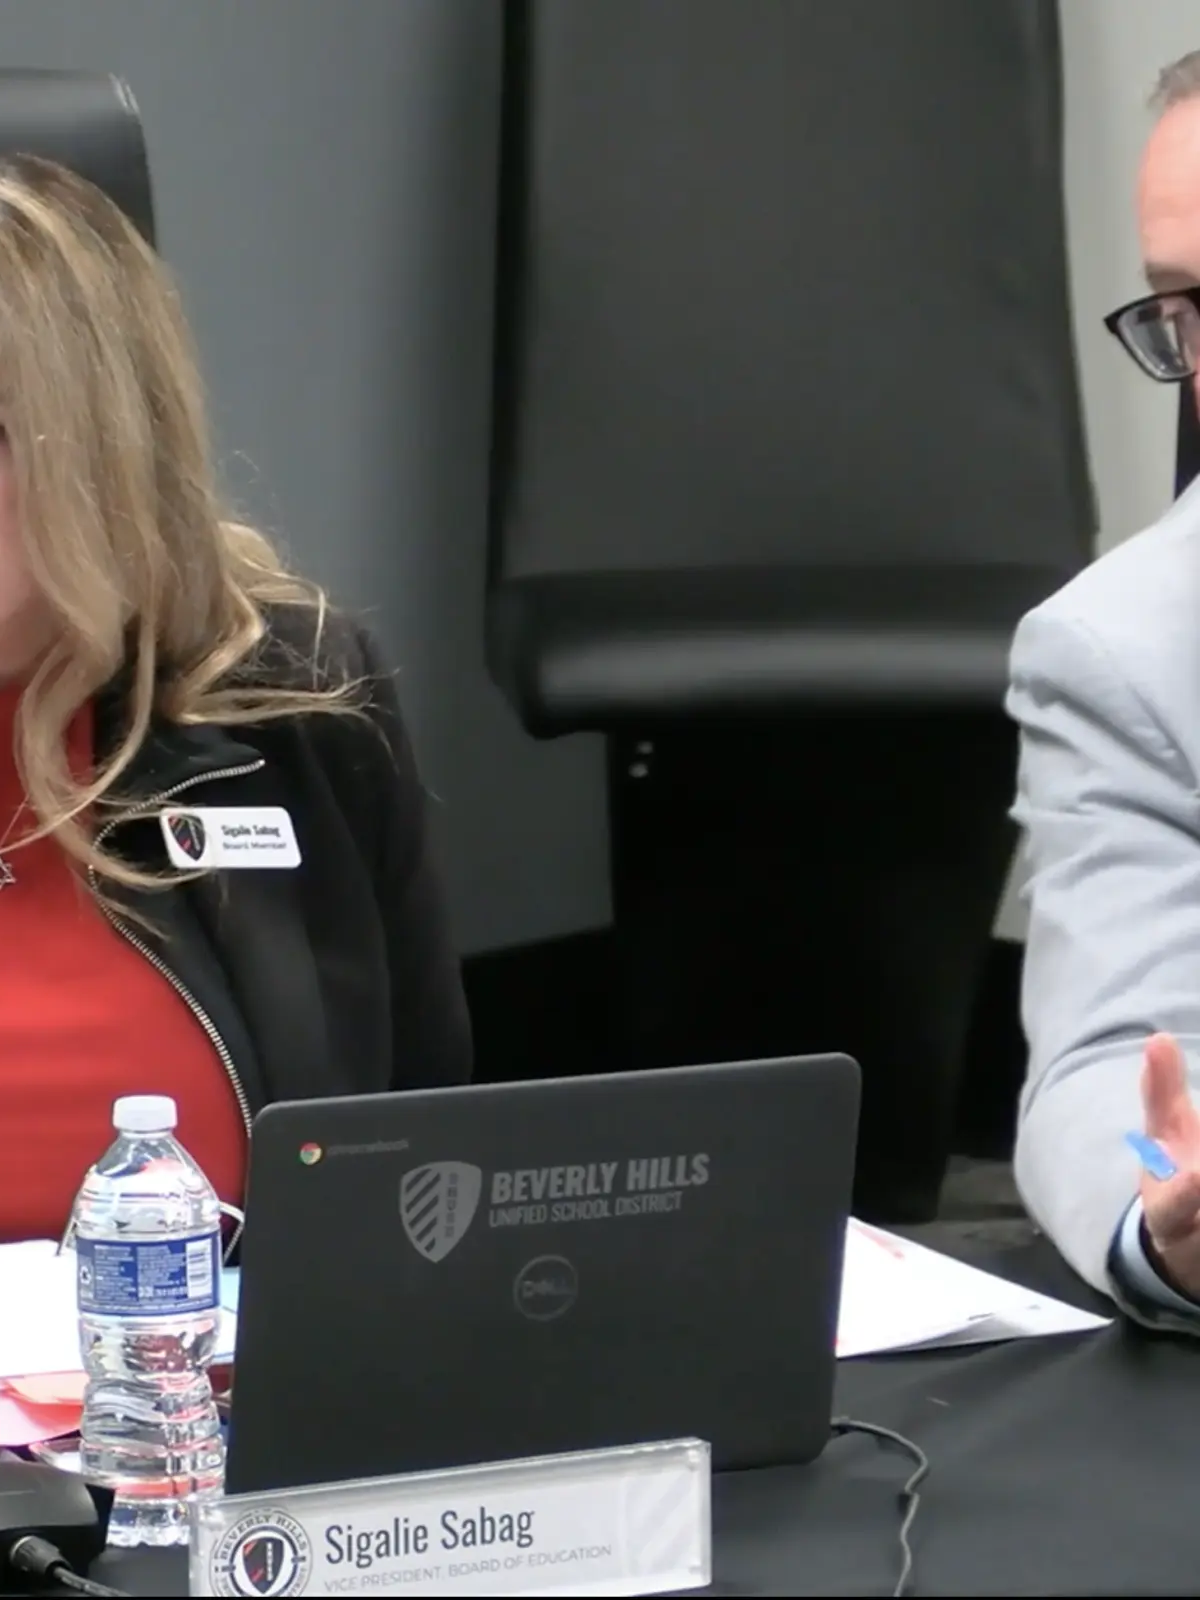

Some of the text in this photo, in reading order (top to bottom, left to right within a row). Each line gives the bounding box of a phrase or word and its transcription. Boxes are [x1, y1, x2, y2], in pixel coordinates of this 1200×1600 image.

[490, 1152, 711, 1205] BEVERLY HILLS
[488, 1190, 683, 1228] UNIFIED SCHOOL DISTRICT
[325, 1518, 429, 1569] Sigalie
[440, 1506, 535, 1549] Sabag
[324, 1577, 358, 1593] VICE
[448, 1559, 501, 1578] BOARD
[503, 1554, 527, 1570] OF
[528, 1544, 612, 1567] EDUCATION
